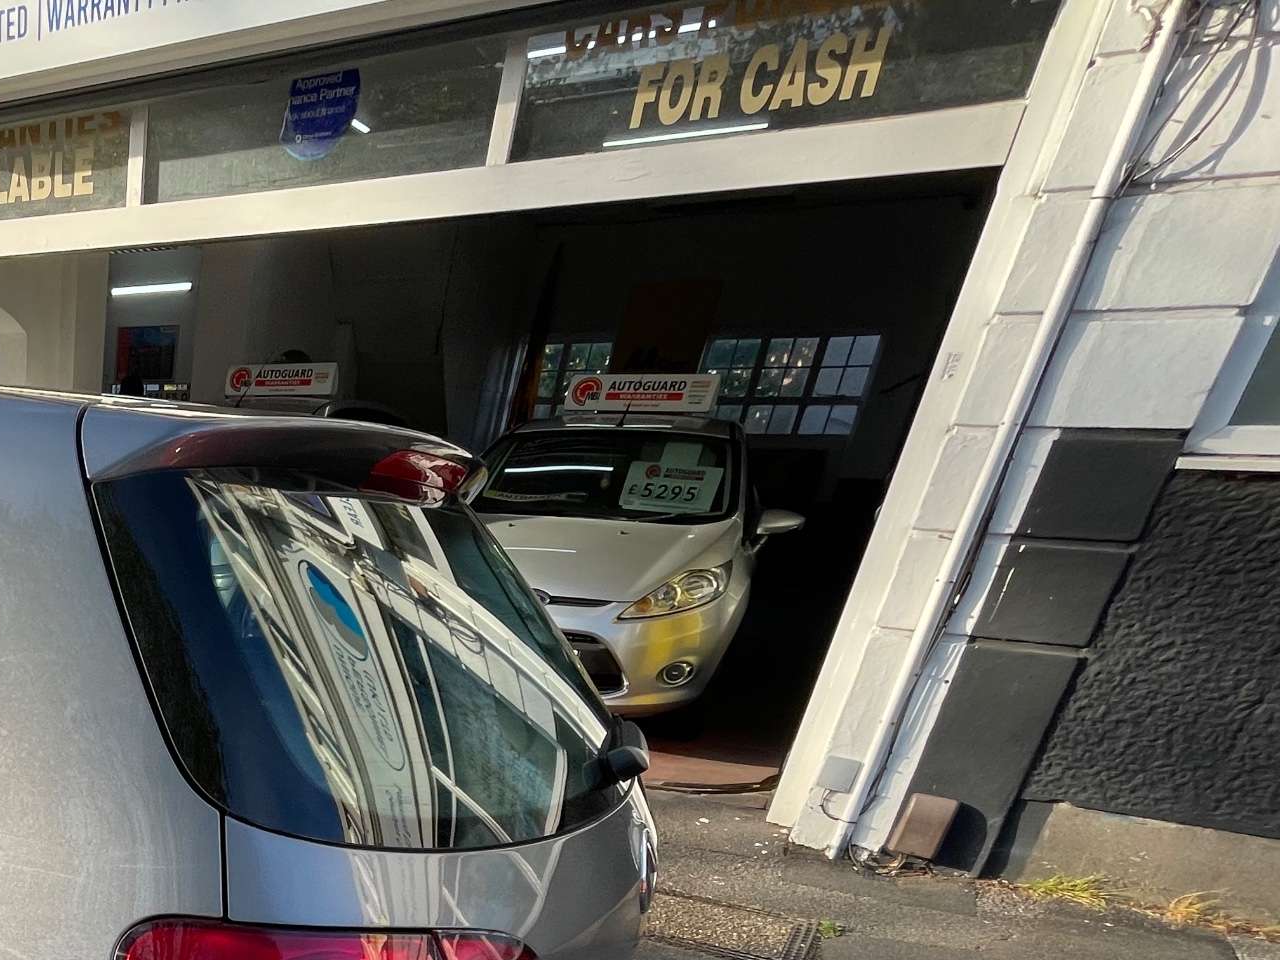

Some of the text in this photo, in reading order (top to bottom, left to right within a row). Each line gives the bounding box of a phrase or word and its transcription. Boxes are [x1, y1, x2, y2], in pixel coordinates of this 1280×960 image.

[47, 0, 153, 33] WARRA
[629, 23, 896, 130] FOR CASH
[320, 86, 356, 100] Partner
[256, 368, 313, 379] AUTOGUARD
[608, 380, 687, 391] AUTOGUARD
